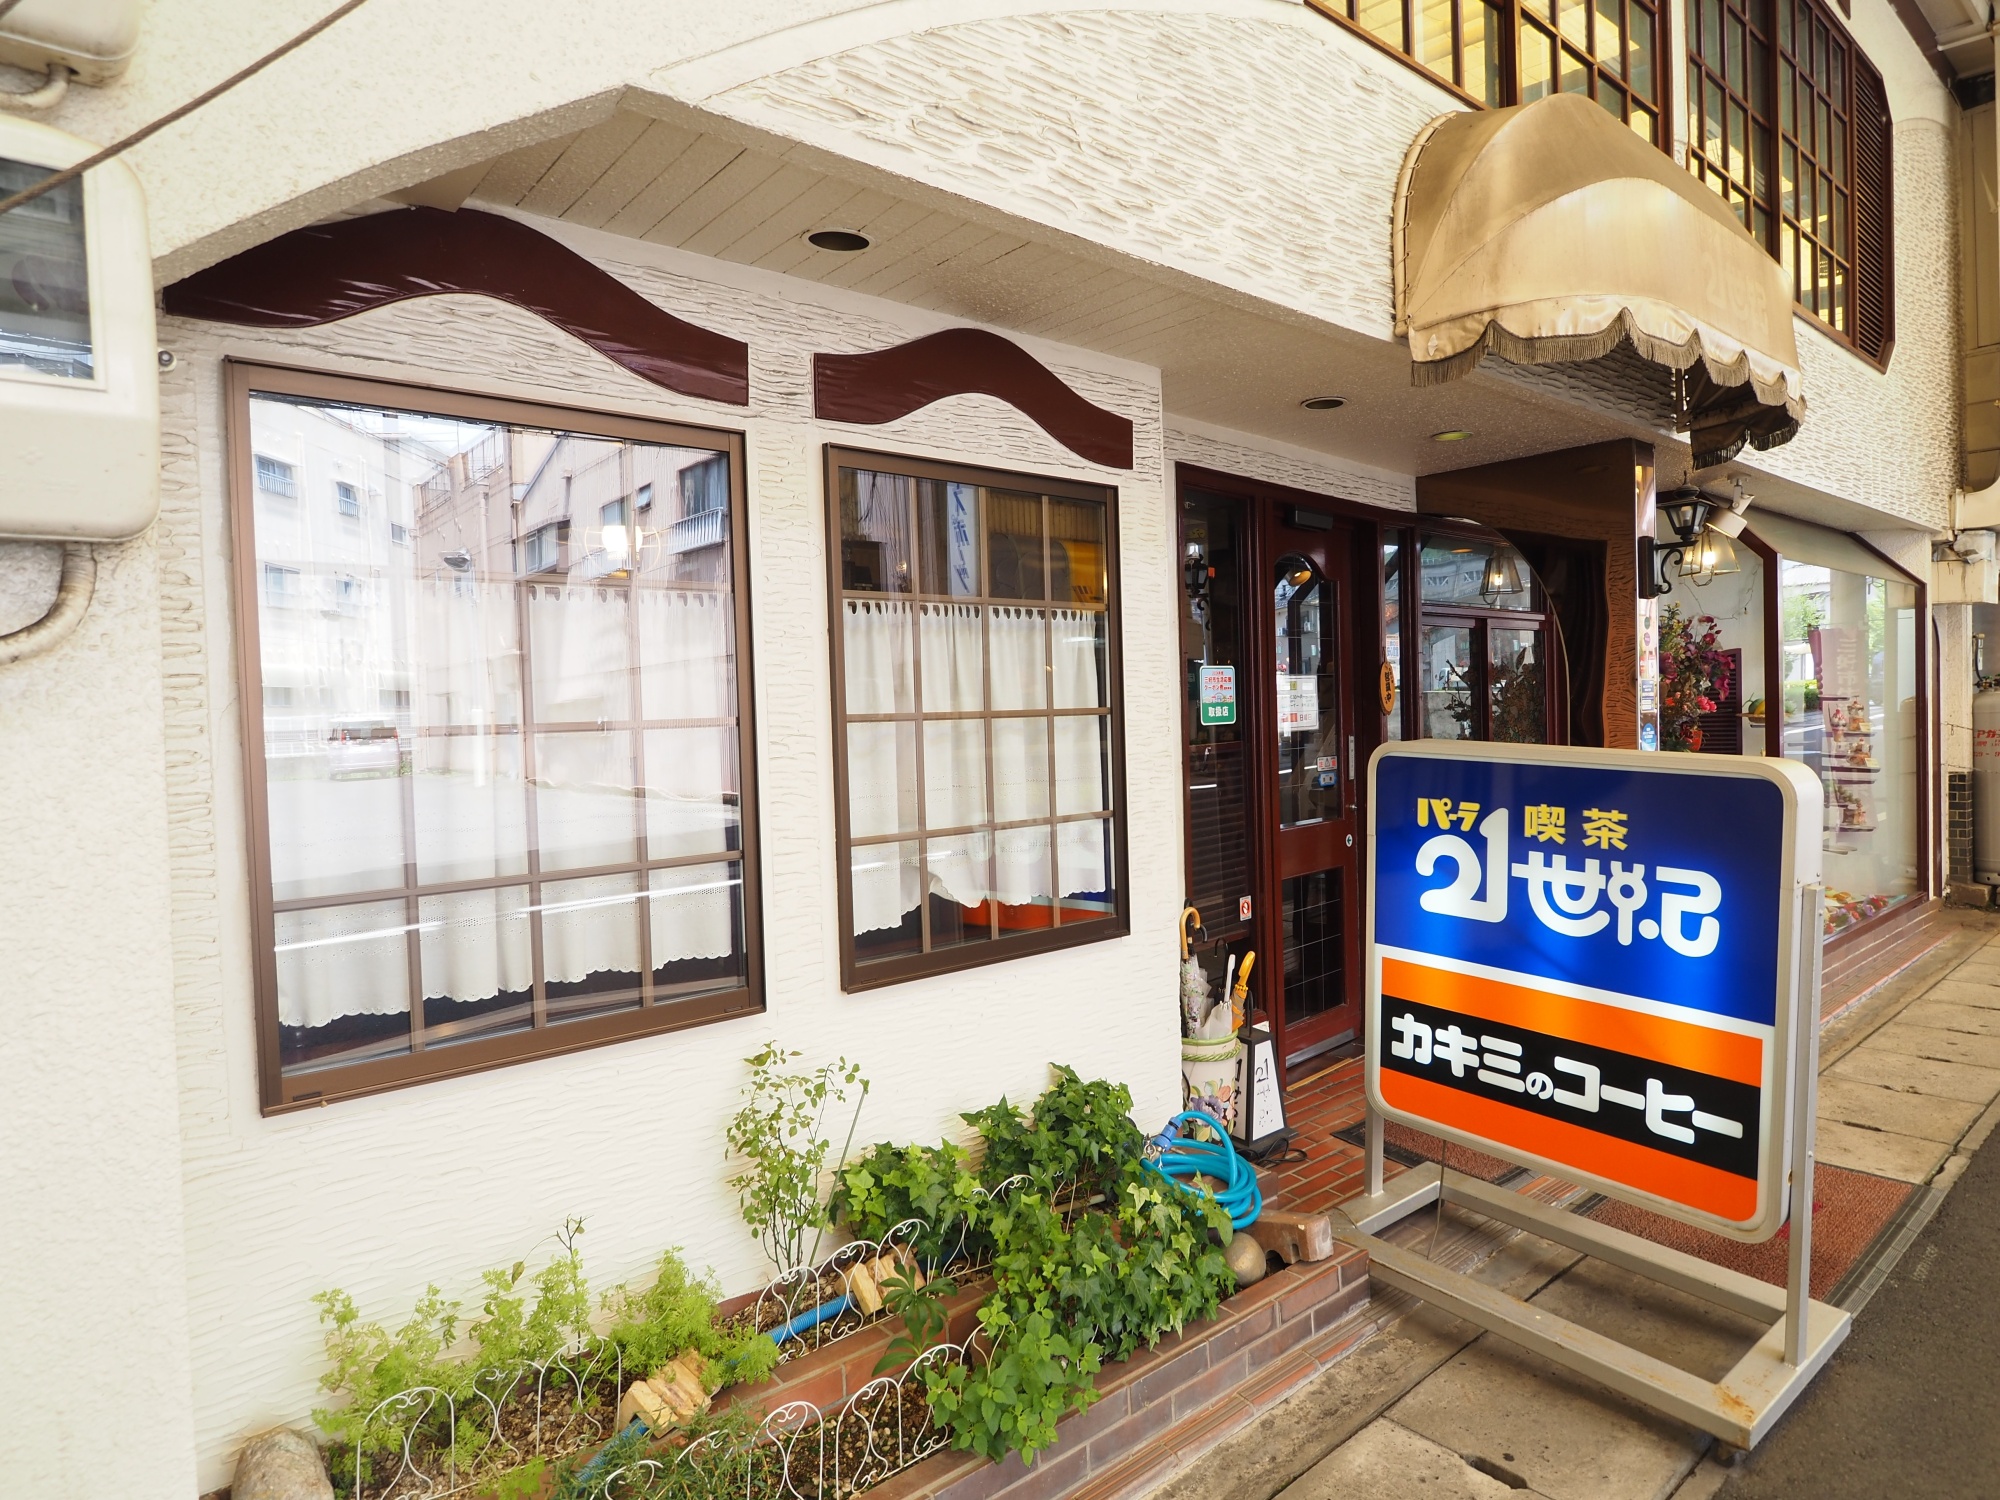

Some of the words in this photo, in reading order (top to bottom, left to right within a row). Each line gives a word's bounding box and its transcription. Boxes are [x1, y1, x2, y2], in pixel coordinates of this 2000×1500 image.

[1208, 706, 1229, 717] 取扱店
[1417, 798, 1480, 832] パーラ
[1524, 804, 1628, 851] 喫茶
[1416, 807, 1722, 957] 21世紀
[1391, 1013, 1743, 1143] カキミのコーヒー
